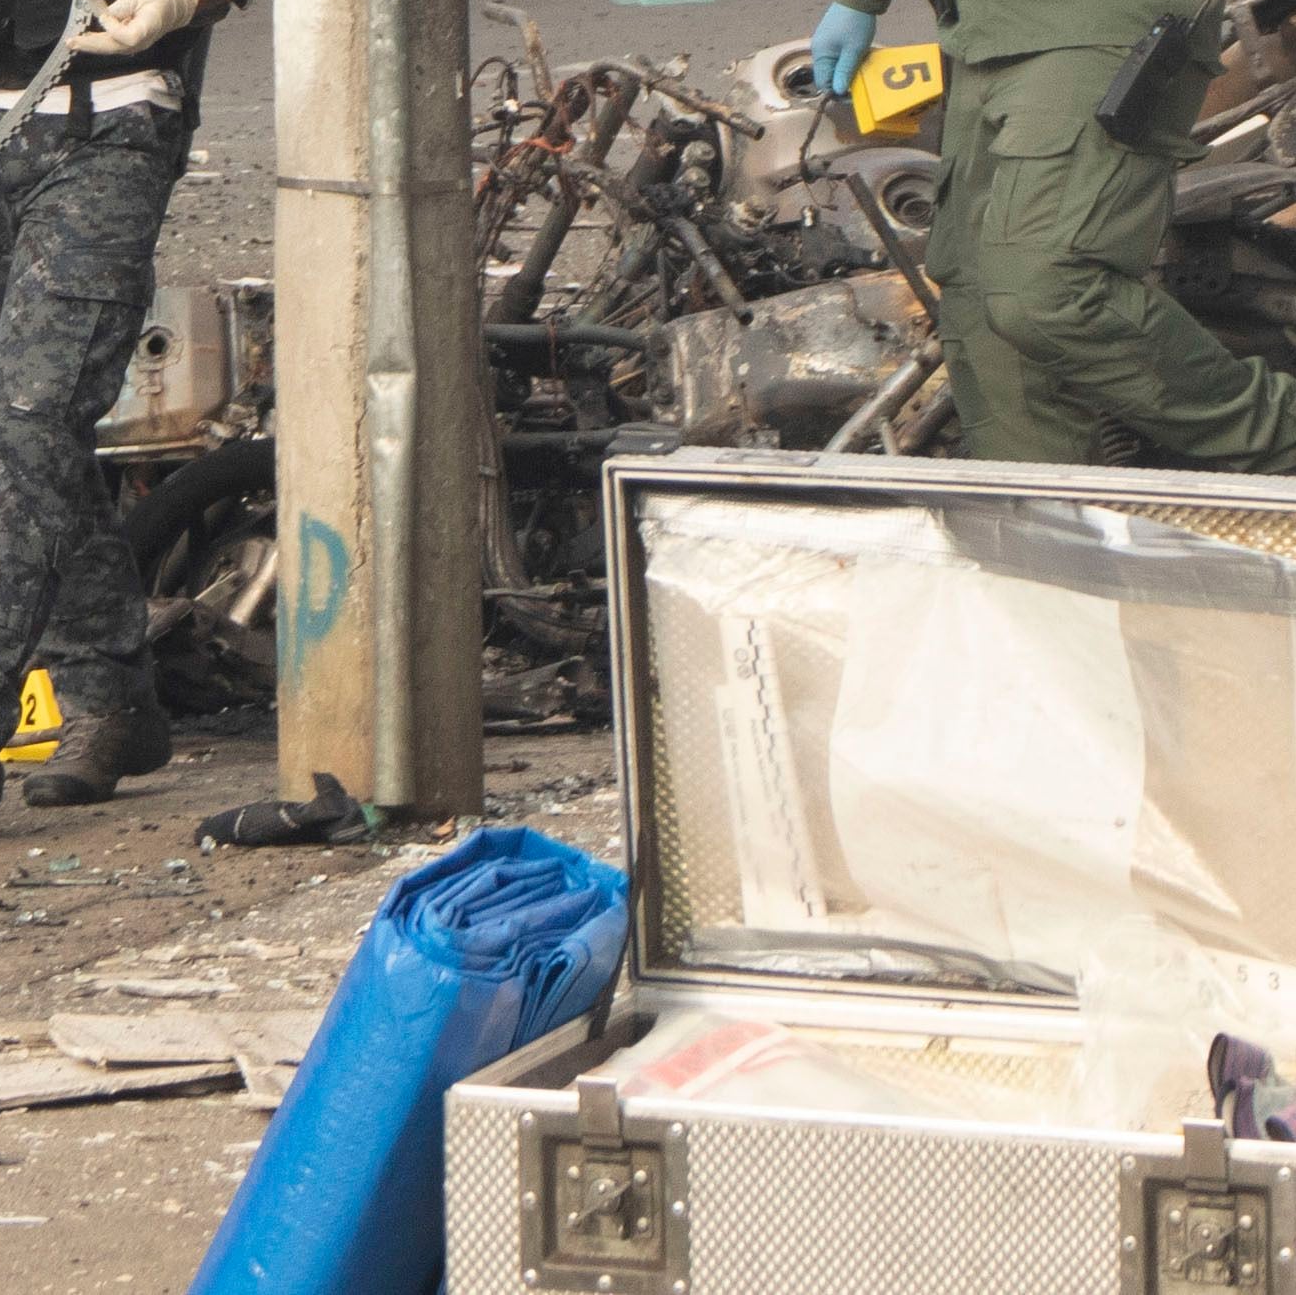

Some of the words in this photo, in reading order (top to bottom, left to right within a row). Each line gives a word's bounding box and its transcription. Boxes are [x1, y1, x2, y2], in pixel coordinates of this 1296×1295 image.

[882, 62, 931, 90] 5
[25, 694, 36, 725] 2
[1268, 971, 1280, 990] 3
